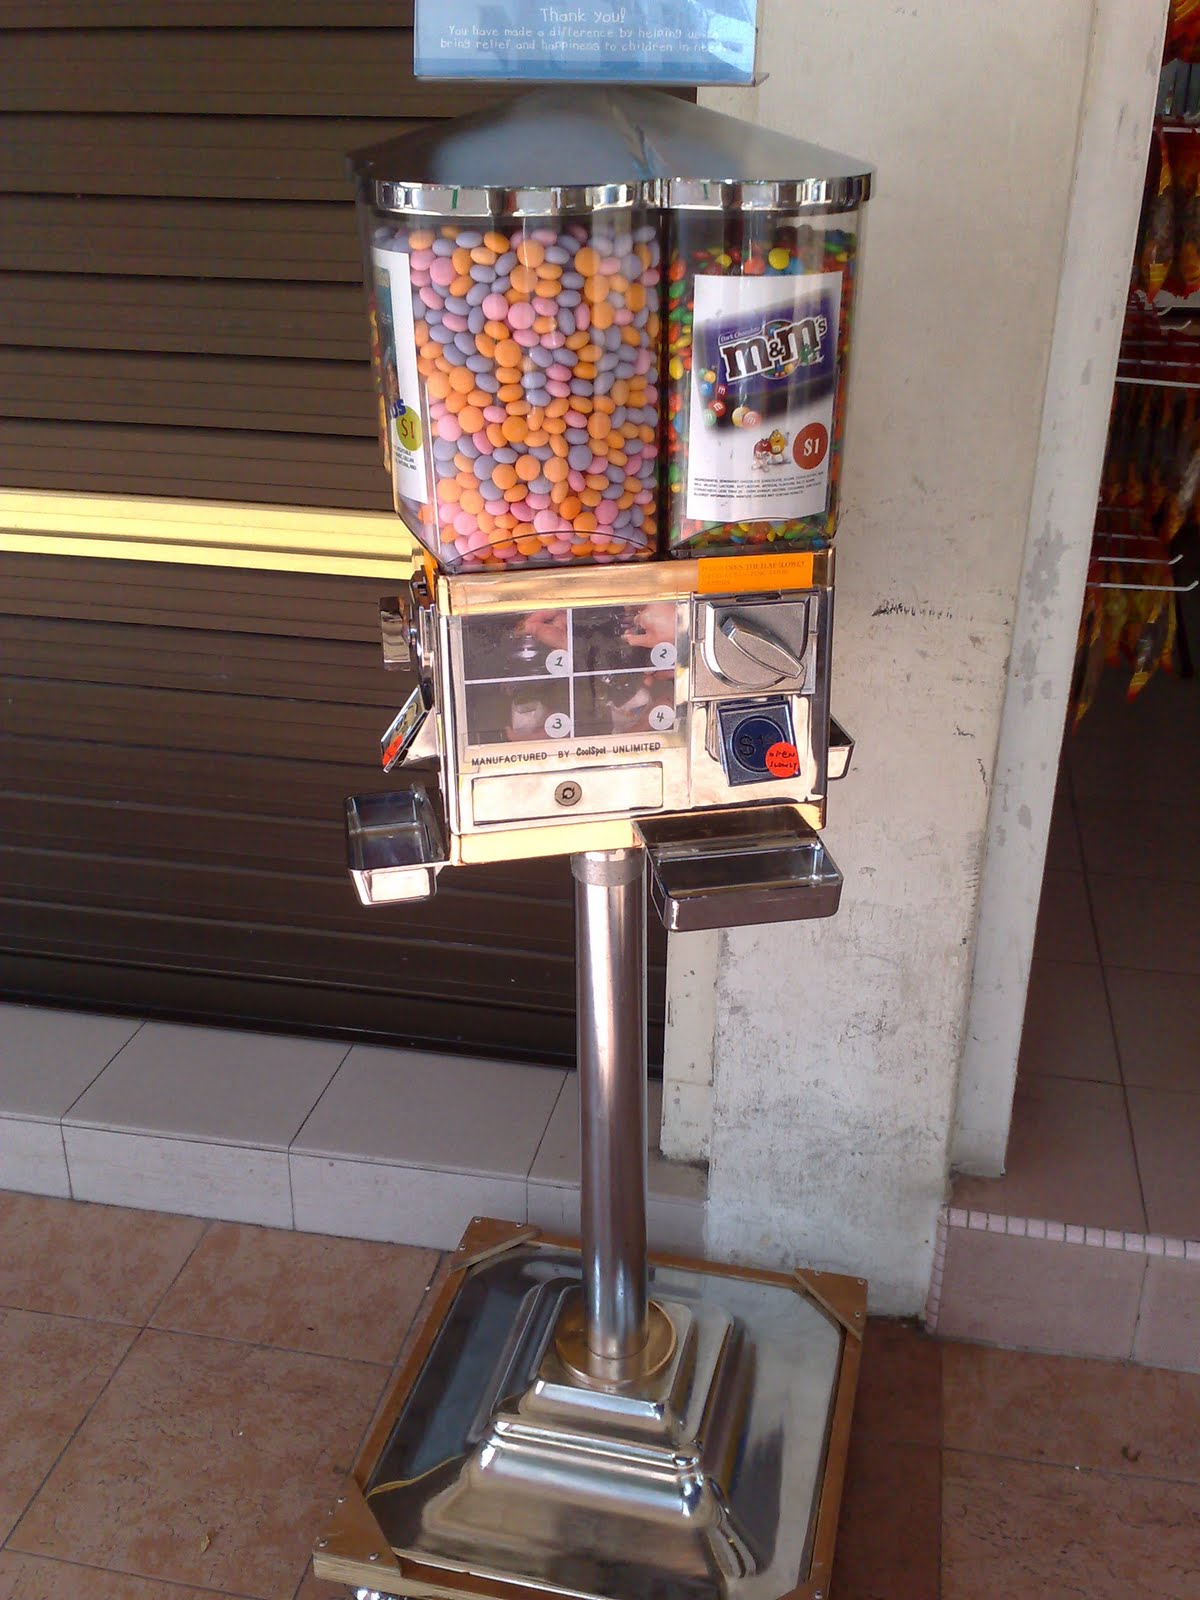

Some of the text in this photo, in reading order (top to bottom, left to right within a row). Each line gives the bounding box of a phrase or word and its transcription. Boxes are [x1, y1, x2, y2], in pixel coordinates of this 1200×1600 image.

[540, 7, 585, 23] Thank
[449, 25, 468, 37] You
[472, 25, 499, 37] have
[504, 26, 532, 37] made
[537, 29, 544, 37] a
[549, 27, 614, 38] difference
[619, 28, 633, 39] by
[638, 28, 681, 39] helping
[440, 38, 471, 49] bring
[476, 38, 510, 49] relief
[515, 40, 535, 49] and
[541, 40, 600, 51] happiness
[605, 42, 617, 51] to
[622, 40, 673, 52] children
[679, 42, 689, 52] in
[401, 417, 415, 439] $1
[803, 437, 820, 457] $1
[659, 648, 667, 659] 2
[554, 656, 563, 667] 1
[552, 718, 562, 729] 3
[656, 711, 665, 722] 4
[471, 752, 548, 767] MANUFACTURED
[558, 750, 570, 759] BY
[613, 742, 661, 754] UNLIMITED
